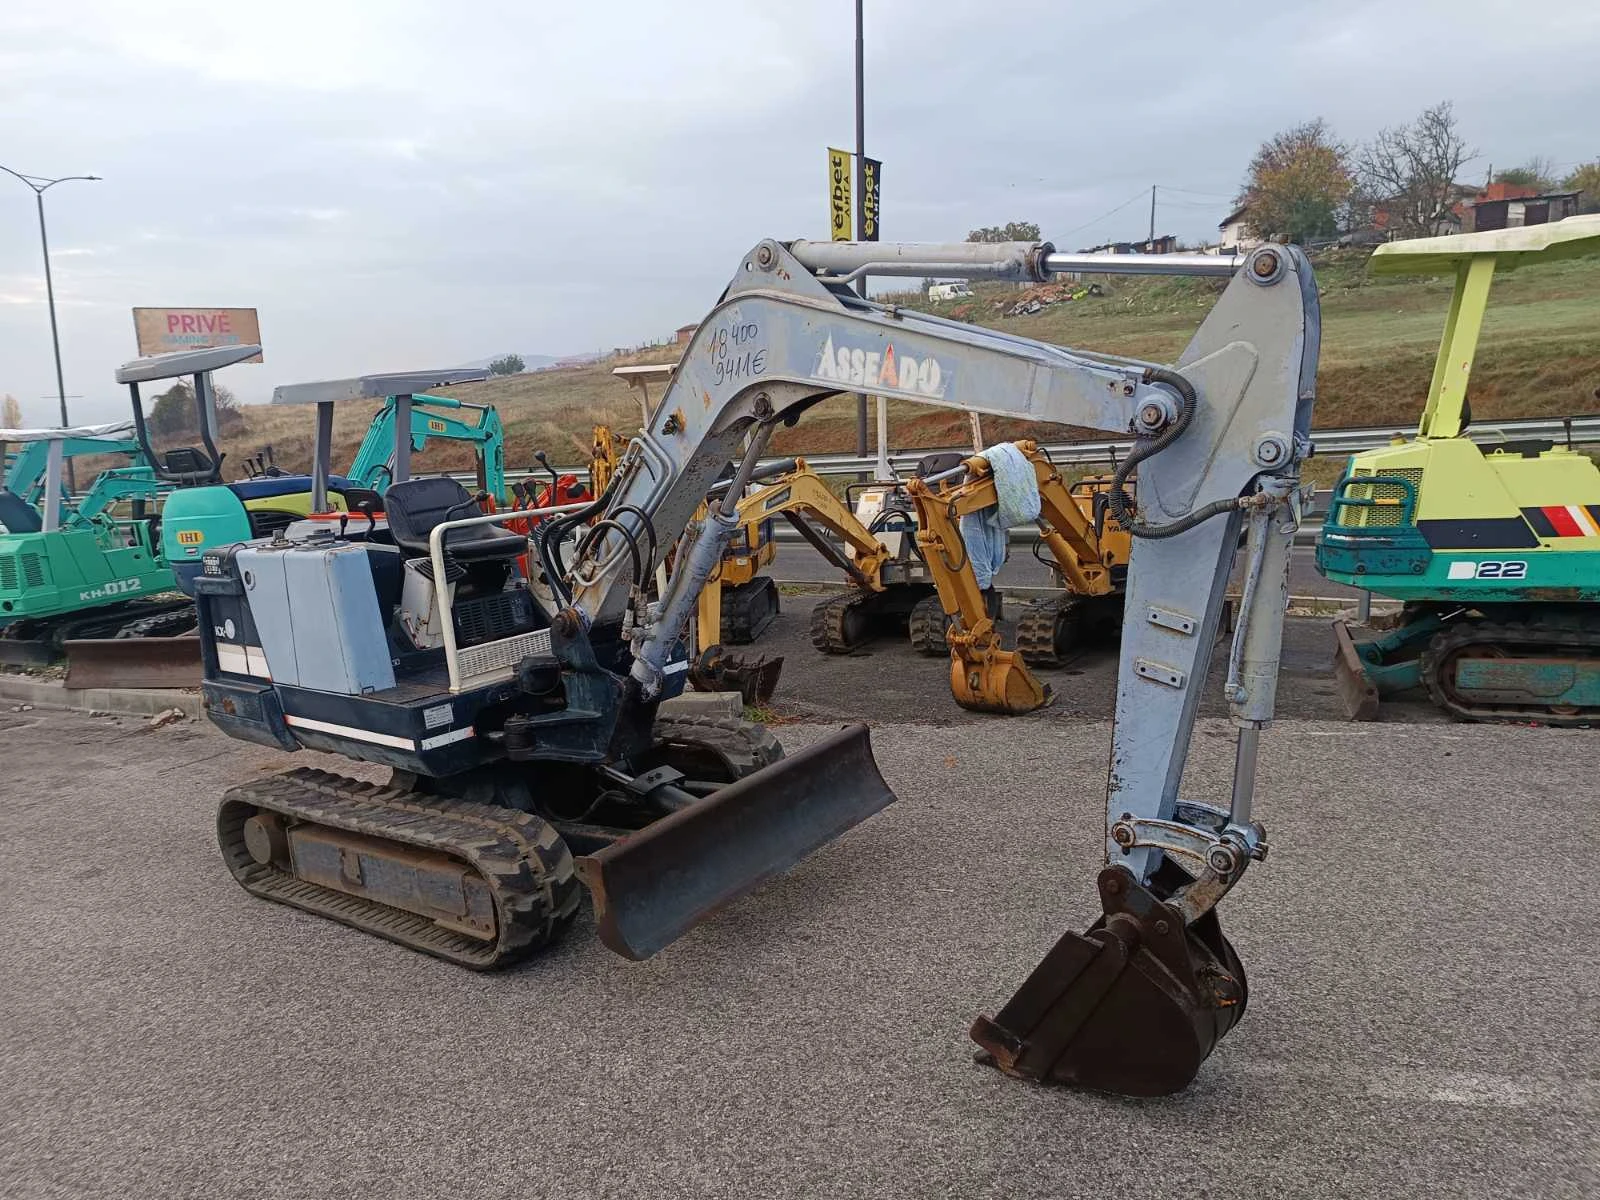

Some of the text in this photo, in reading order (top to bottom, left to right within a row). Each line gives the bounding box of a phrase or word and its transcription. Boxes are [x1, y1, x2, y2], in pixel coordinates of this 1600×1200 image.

[832, 155, 844, 231] efbet
[864, 163, 874, 237] efbet
[816, 331, 941, 394] ASSEADO
[431, 421, 444, 432] IHI
[180, 531, 199, 544] IHI
